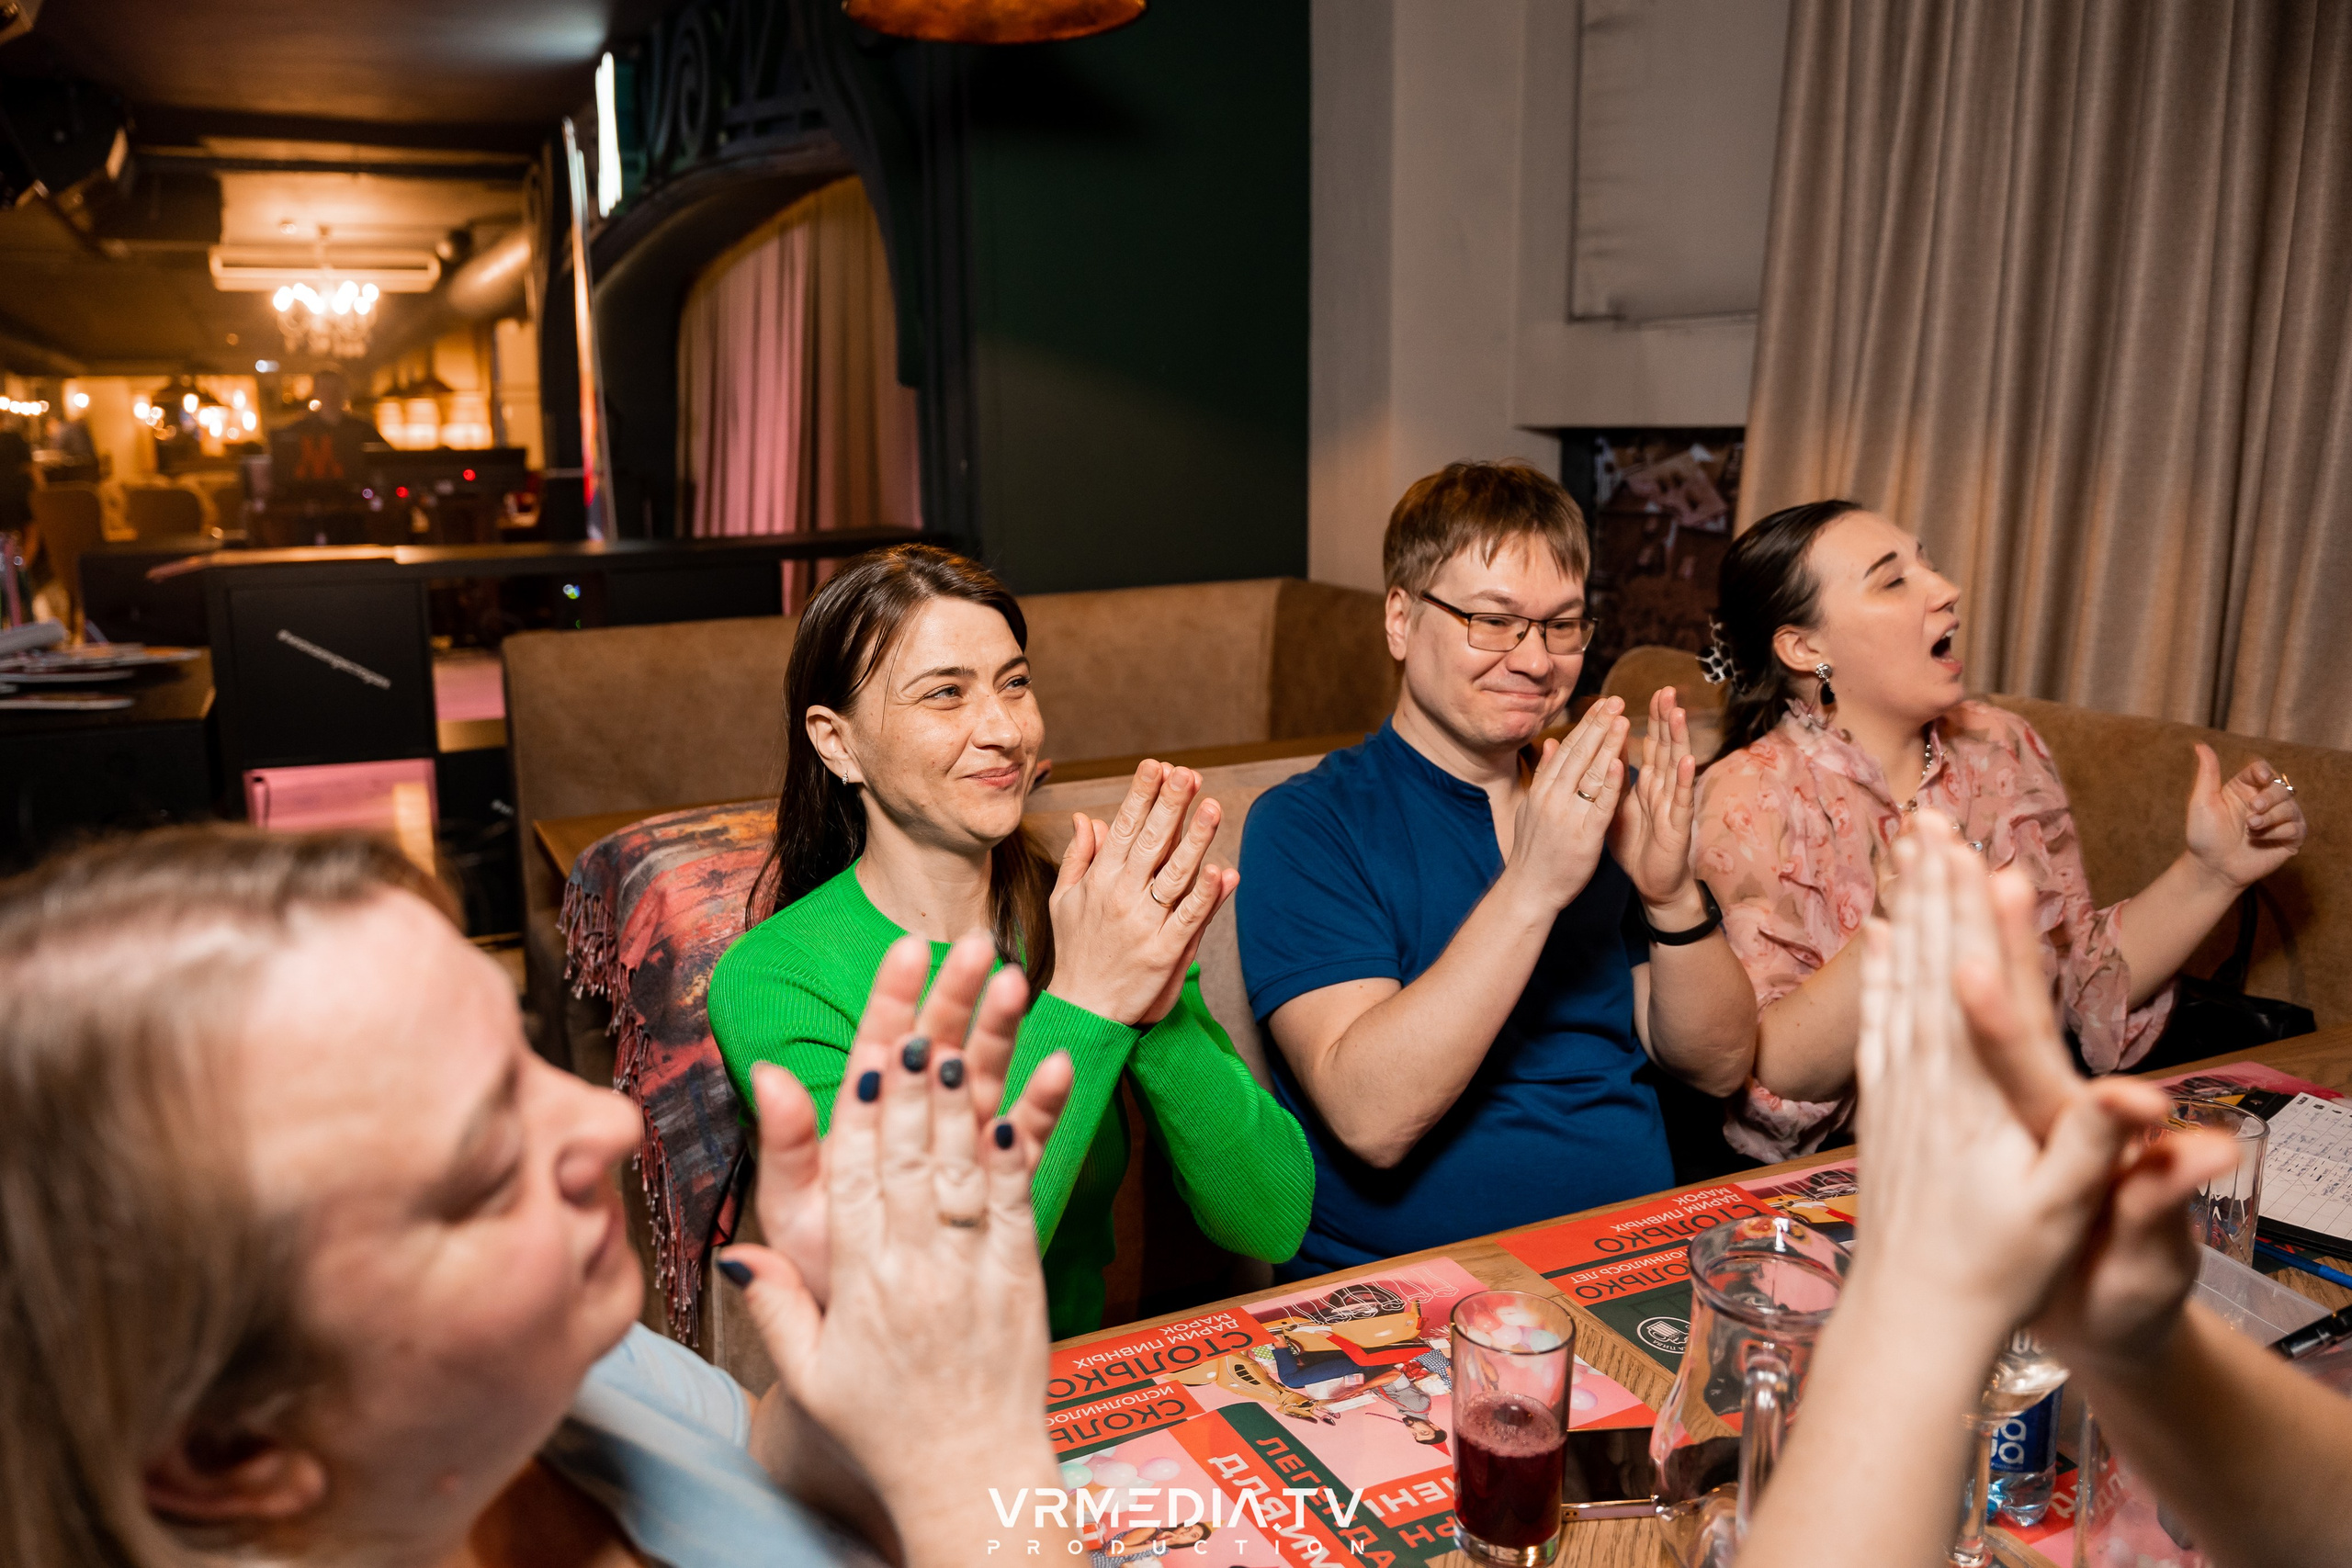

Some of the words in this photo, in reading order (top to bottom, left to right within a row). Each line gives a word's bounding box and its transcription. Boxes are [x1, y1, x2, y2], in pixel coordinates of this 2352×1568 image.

[1671, 1187, 1731, 1206] МАРОК
[1682, 1193, 1743, 1215] ДАРИМ
[1610, 1209, 1685, 1233] ПИВНЫХ
[1570, 1271, 1599, 1284] ЛЕТ
[1575, 1260, 1690, 1300] ОЛЬКО
[1159, 1313, 1231, 1335] МАРОК
[1167, 1319, 1240, 1345] ДАРИМ
[1046, 1331, 1253, 1398] СТОЛЬКО
[1072, 1339, 1166, 1370] ПИВНЫХ
[1045, 1385, 1175, 1427] ИСПОЛНИЛОС
[1049, 1399, 1186, 1444] СКОЛЬ
